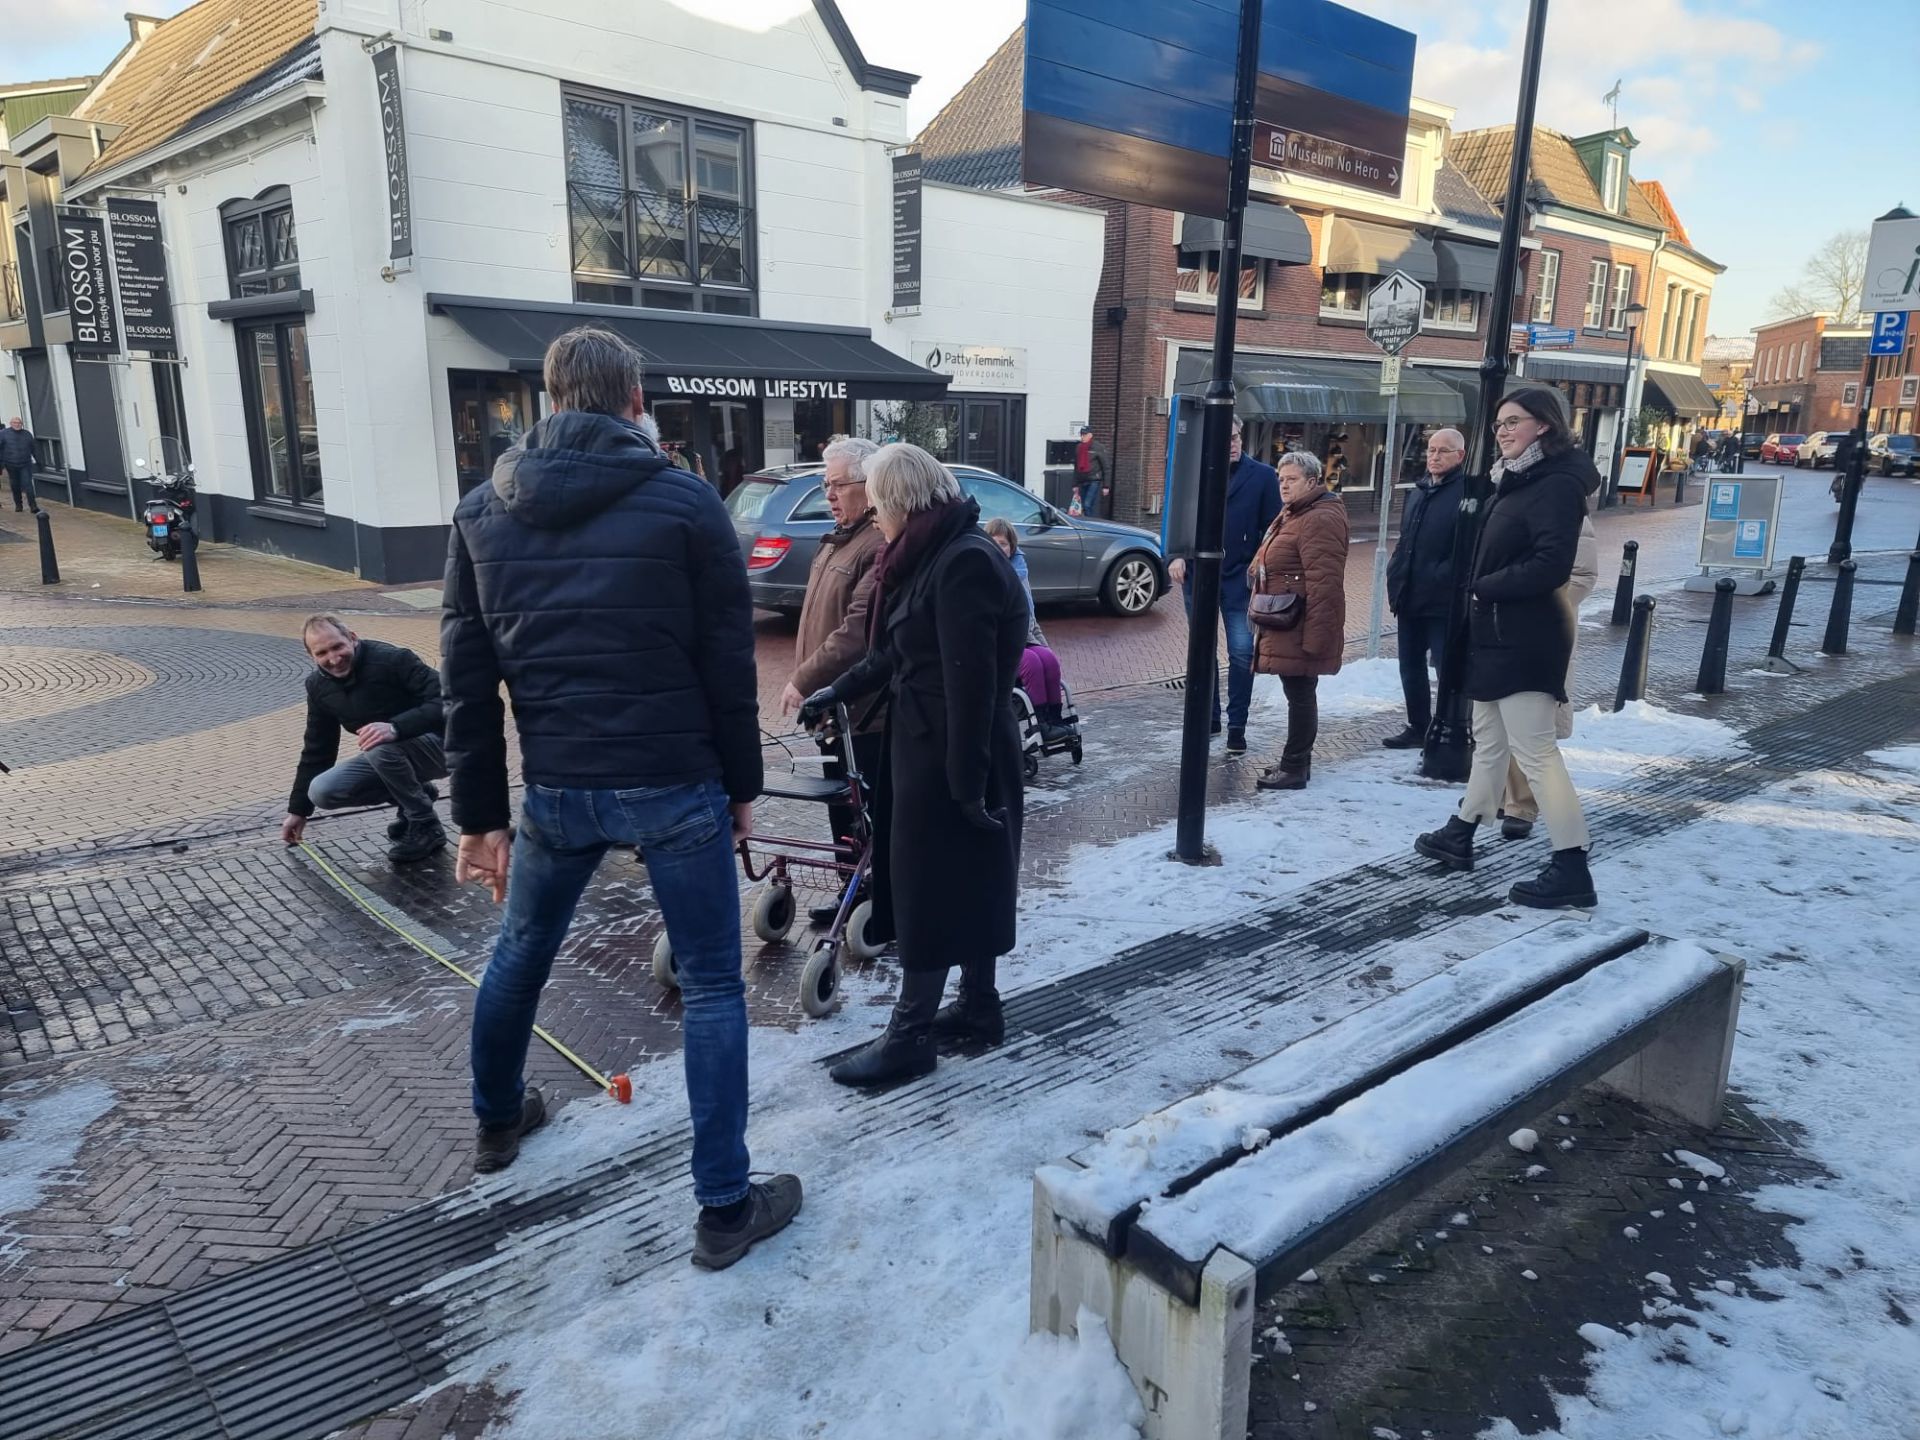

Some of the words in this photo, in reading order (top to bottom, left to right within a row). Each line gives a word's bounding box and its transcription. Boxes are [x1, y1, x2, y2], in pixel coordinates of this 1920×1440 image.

[379, 72, 402, 240] BLOSSOM
[396, 127, 404, 166] winkel
[1286, 143, 1334, 168] Museum
[1337, 156, 1351, 173] No
[1355, 161, 1379, 180] Hero
[110, 213, 156, 223] BLOSSOM
[89, 230, 102, 246] jou
[404, 222, 409, 238] De
[92, 245, 102, 266] voor
[64, 228, 98, 342] BLOSSOM
[93, 268, 105, 294] winkel
[98, 296, 110, 328] lifestyle
[126, 325, 171, 334] BLOSSOM
[1880, 313, 1900, 336] P
[102, 330, 112, 343] De
[944, 352, 971, 366] Patty
[974, 354, 1015, 367] Temmink
[667, 376, 756, 396] BLOSSOM
[765, 380, 847, 399] LIFESTYLE
